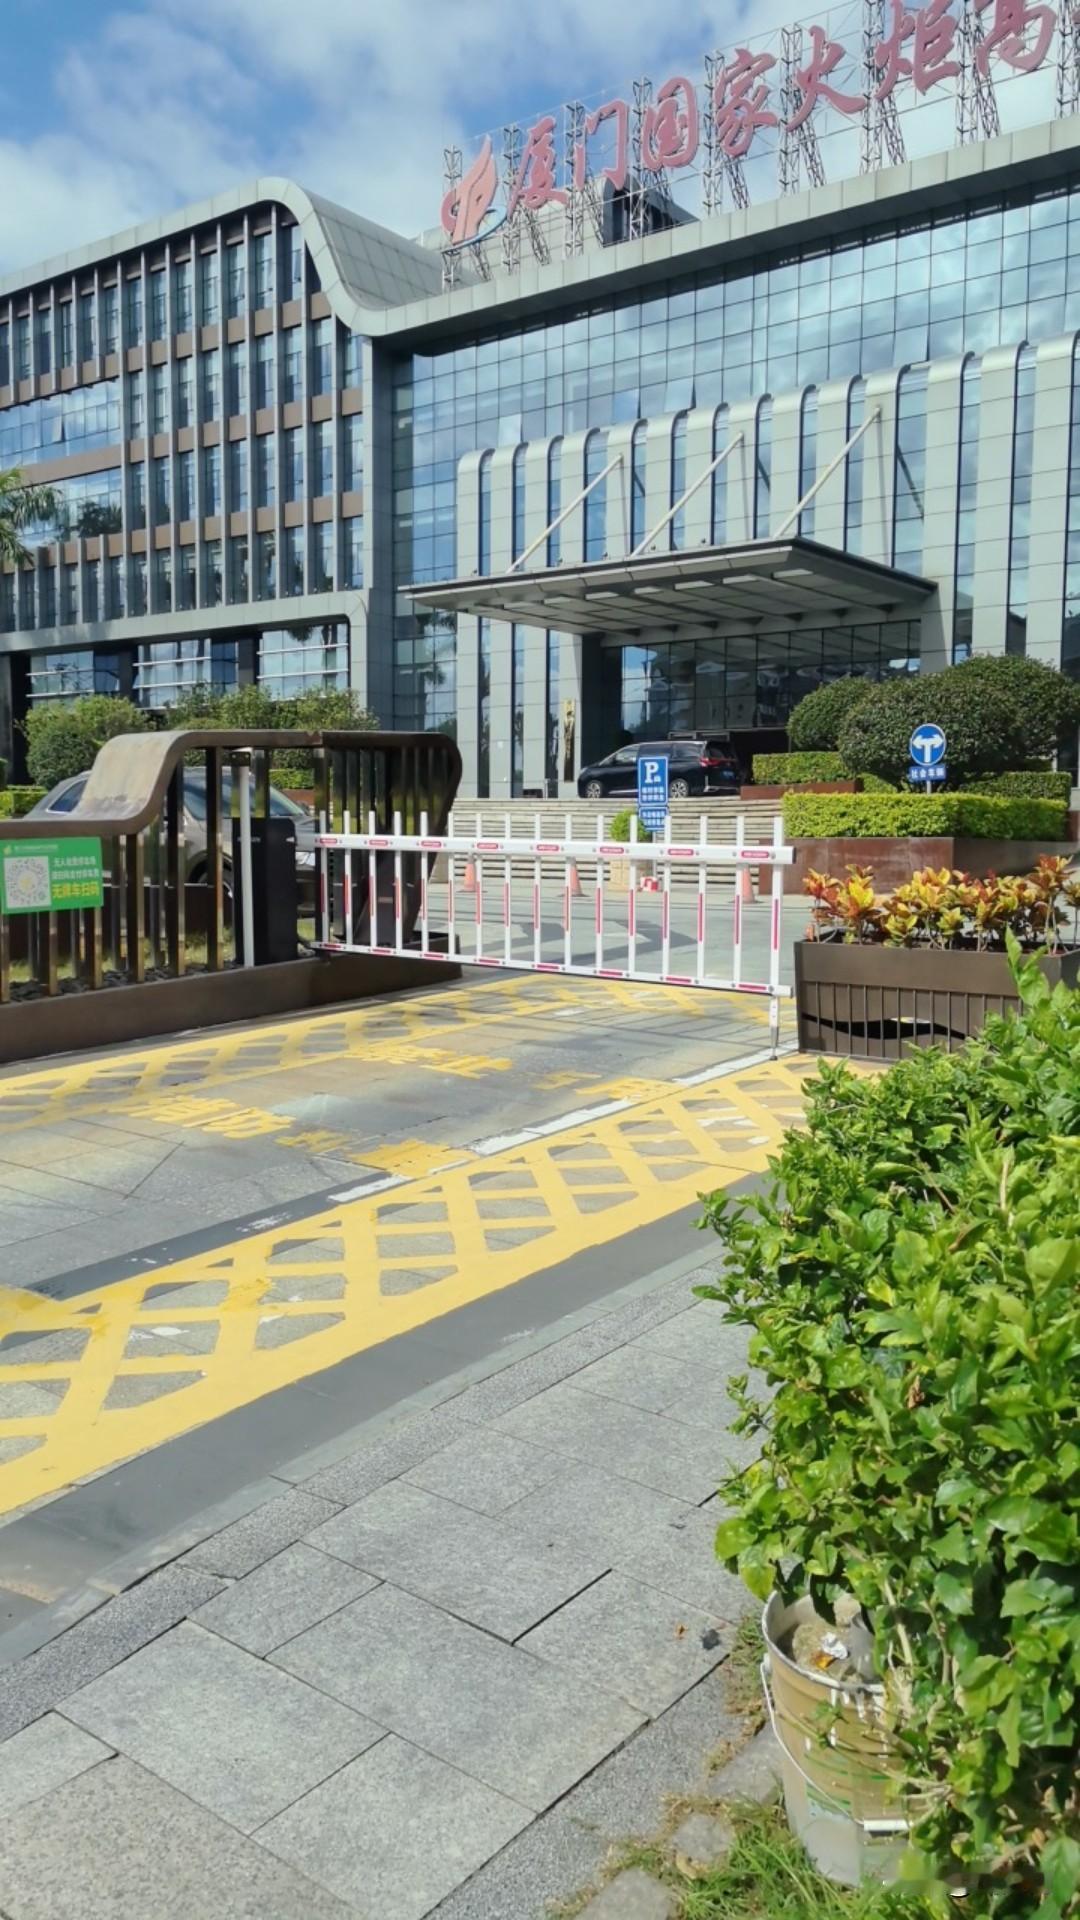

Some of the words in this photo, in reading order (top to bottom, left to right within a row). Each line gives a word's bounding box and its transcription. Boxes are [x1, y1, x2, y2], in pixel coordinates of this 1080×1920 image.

[507, 0, 1080, 216] 厦门国家火炬高
[644, 762, 659, 783] P
